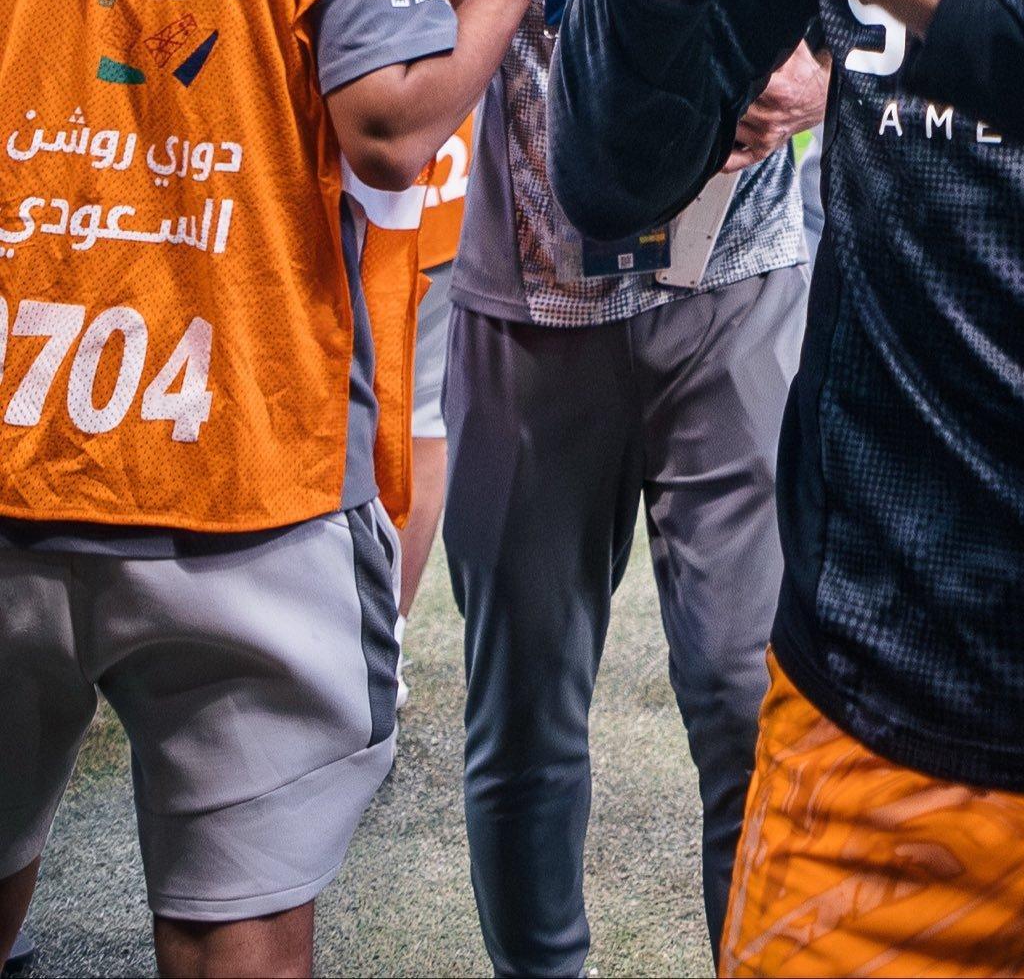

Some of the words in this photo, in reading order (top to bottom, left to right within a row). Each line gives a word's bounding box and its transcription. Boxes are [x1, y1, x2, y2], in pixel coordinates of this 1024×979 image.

[6, 105, 138, 171] روشن
[146, 135, 244, 187] دوري
[0, 196, 234, 259] السعودي
[0, 294, 214, 443] 704
